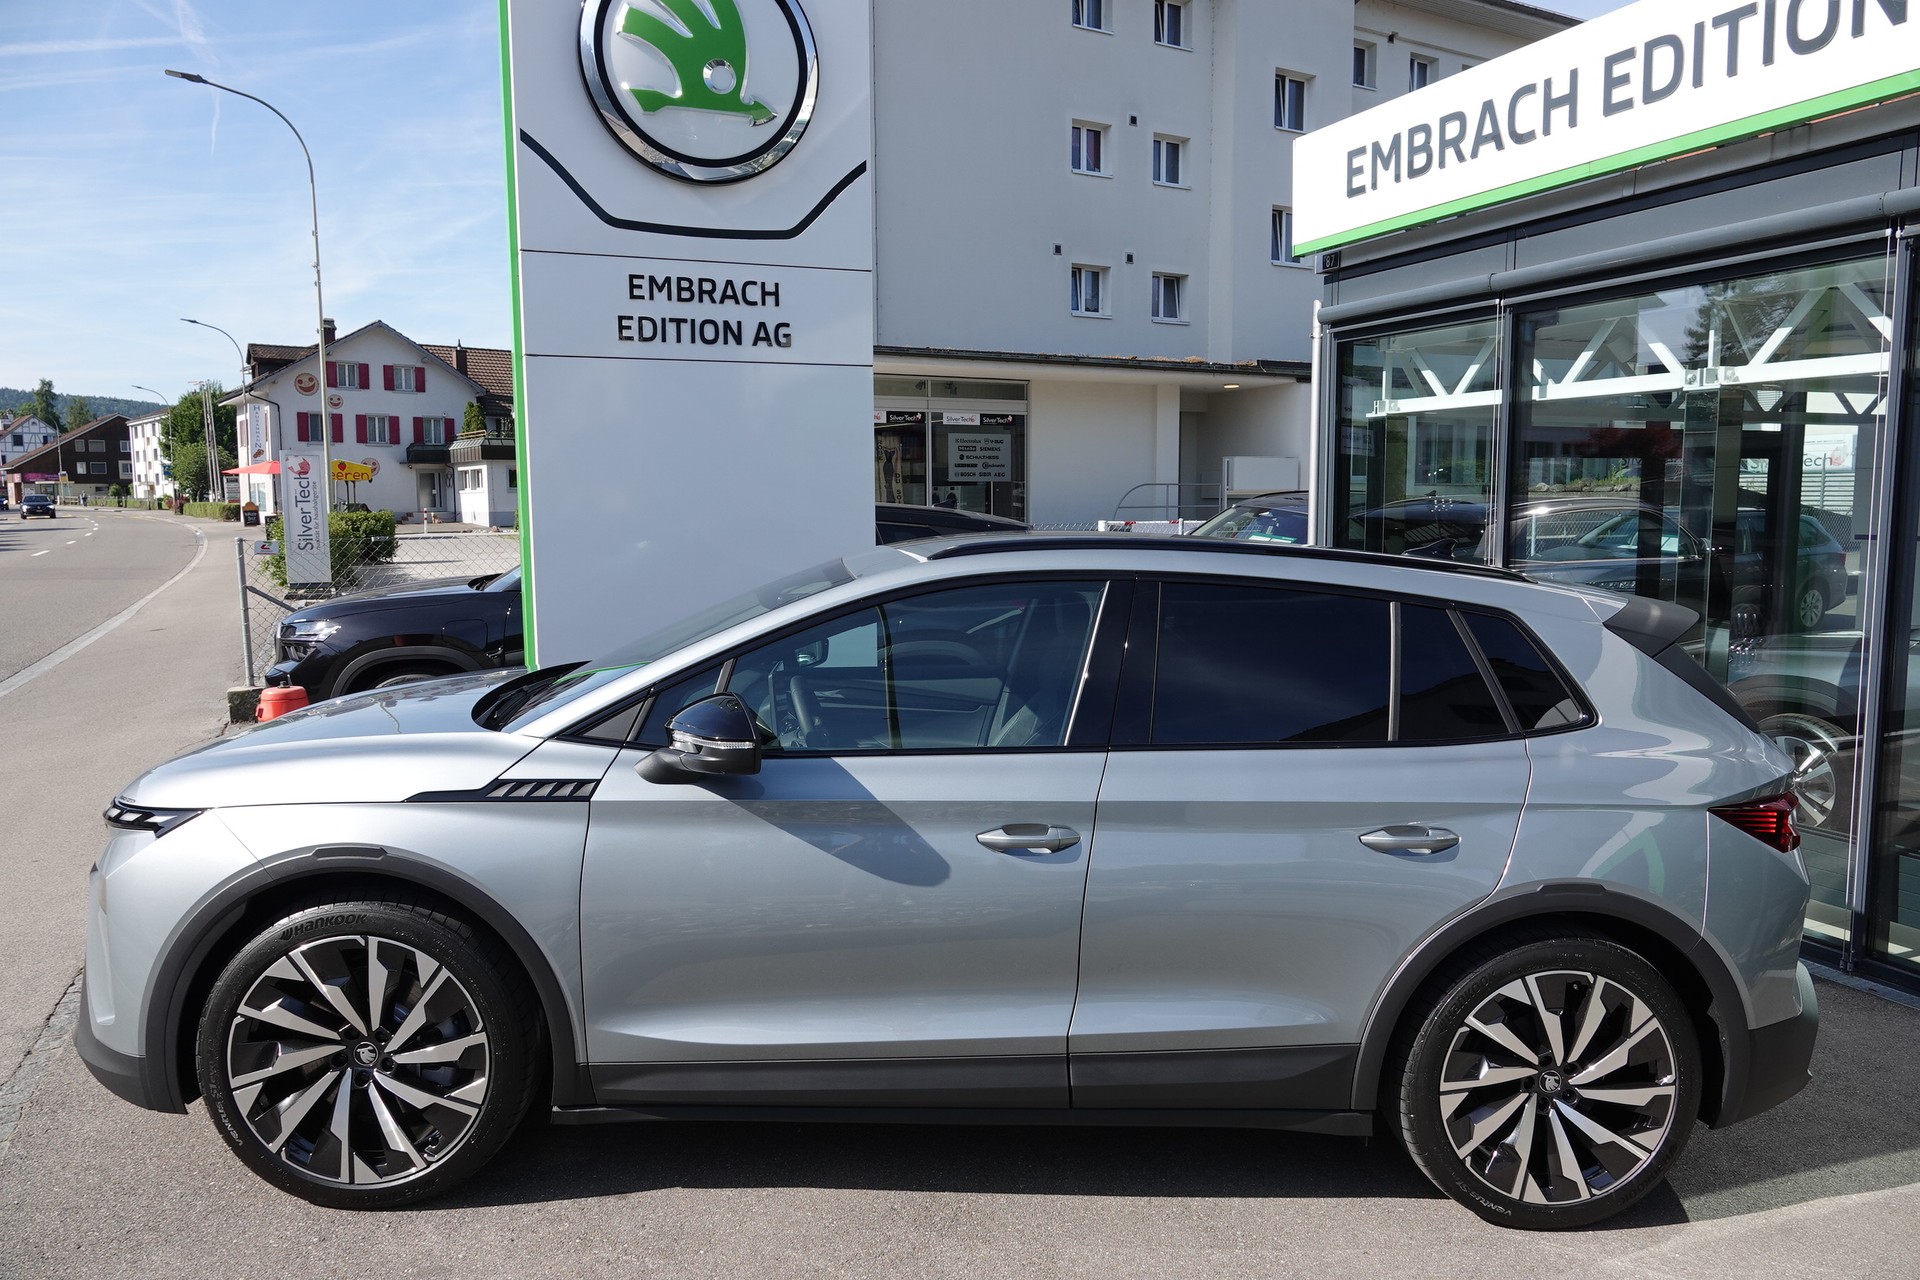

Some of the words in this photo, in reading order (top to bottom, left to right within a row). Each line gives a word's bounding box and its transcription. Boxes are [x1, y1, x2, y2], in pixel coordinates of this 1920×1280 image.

[1346, 68, 1579, 199] EMBRACH
[1325, 254, 1336, 268] 87
[628, 273, 780, 307] EMBRACH
[617, 315, 743, 346] EDITION
[752, 321, 792, 348] AG
